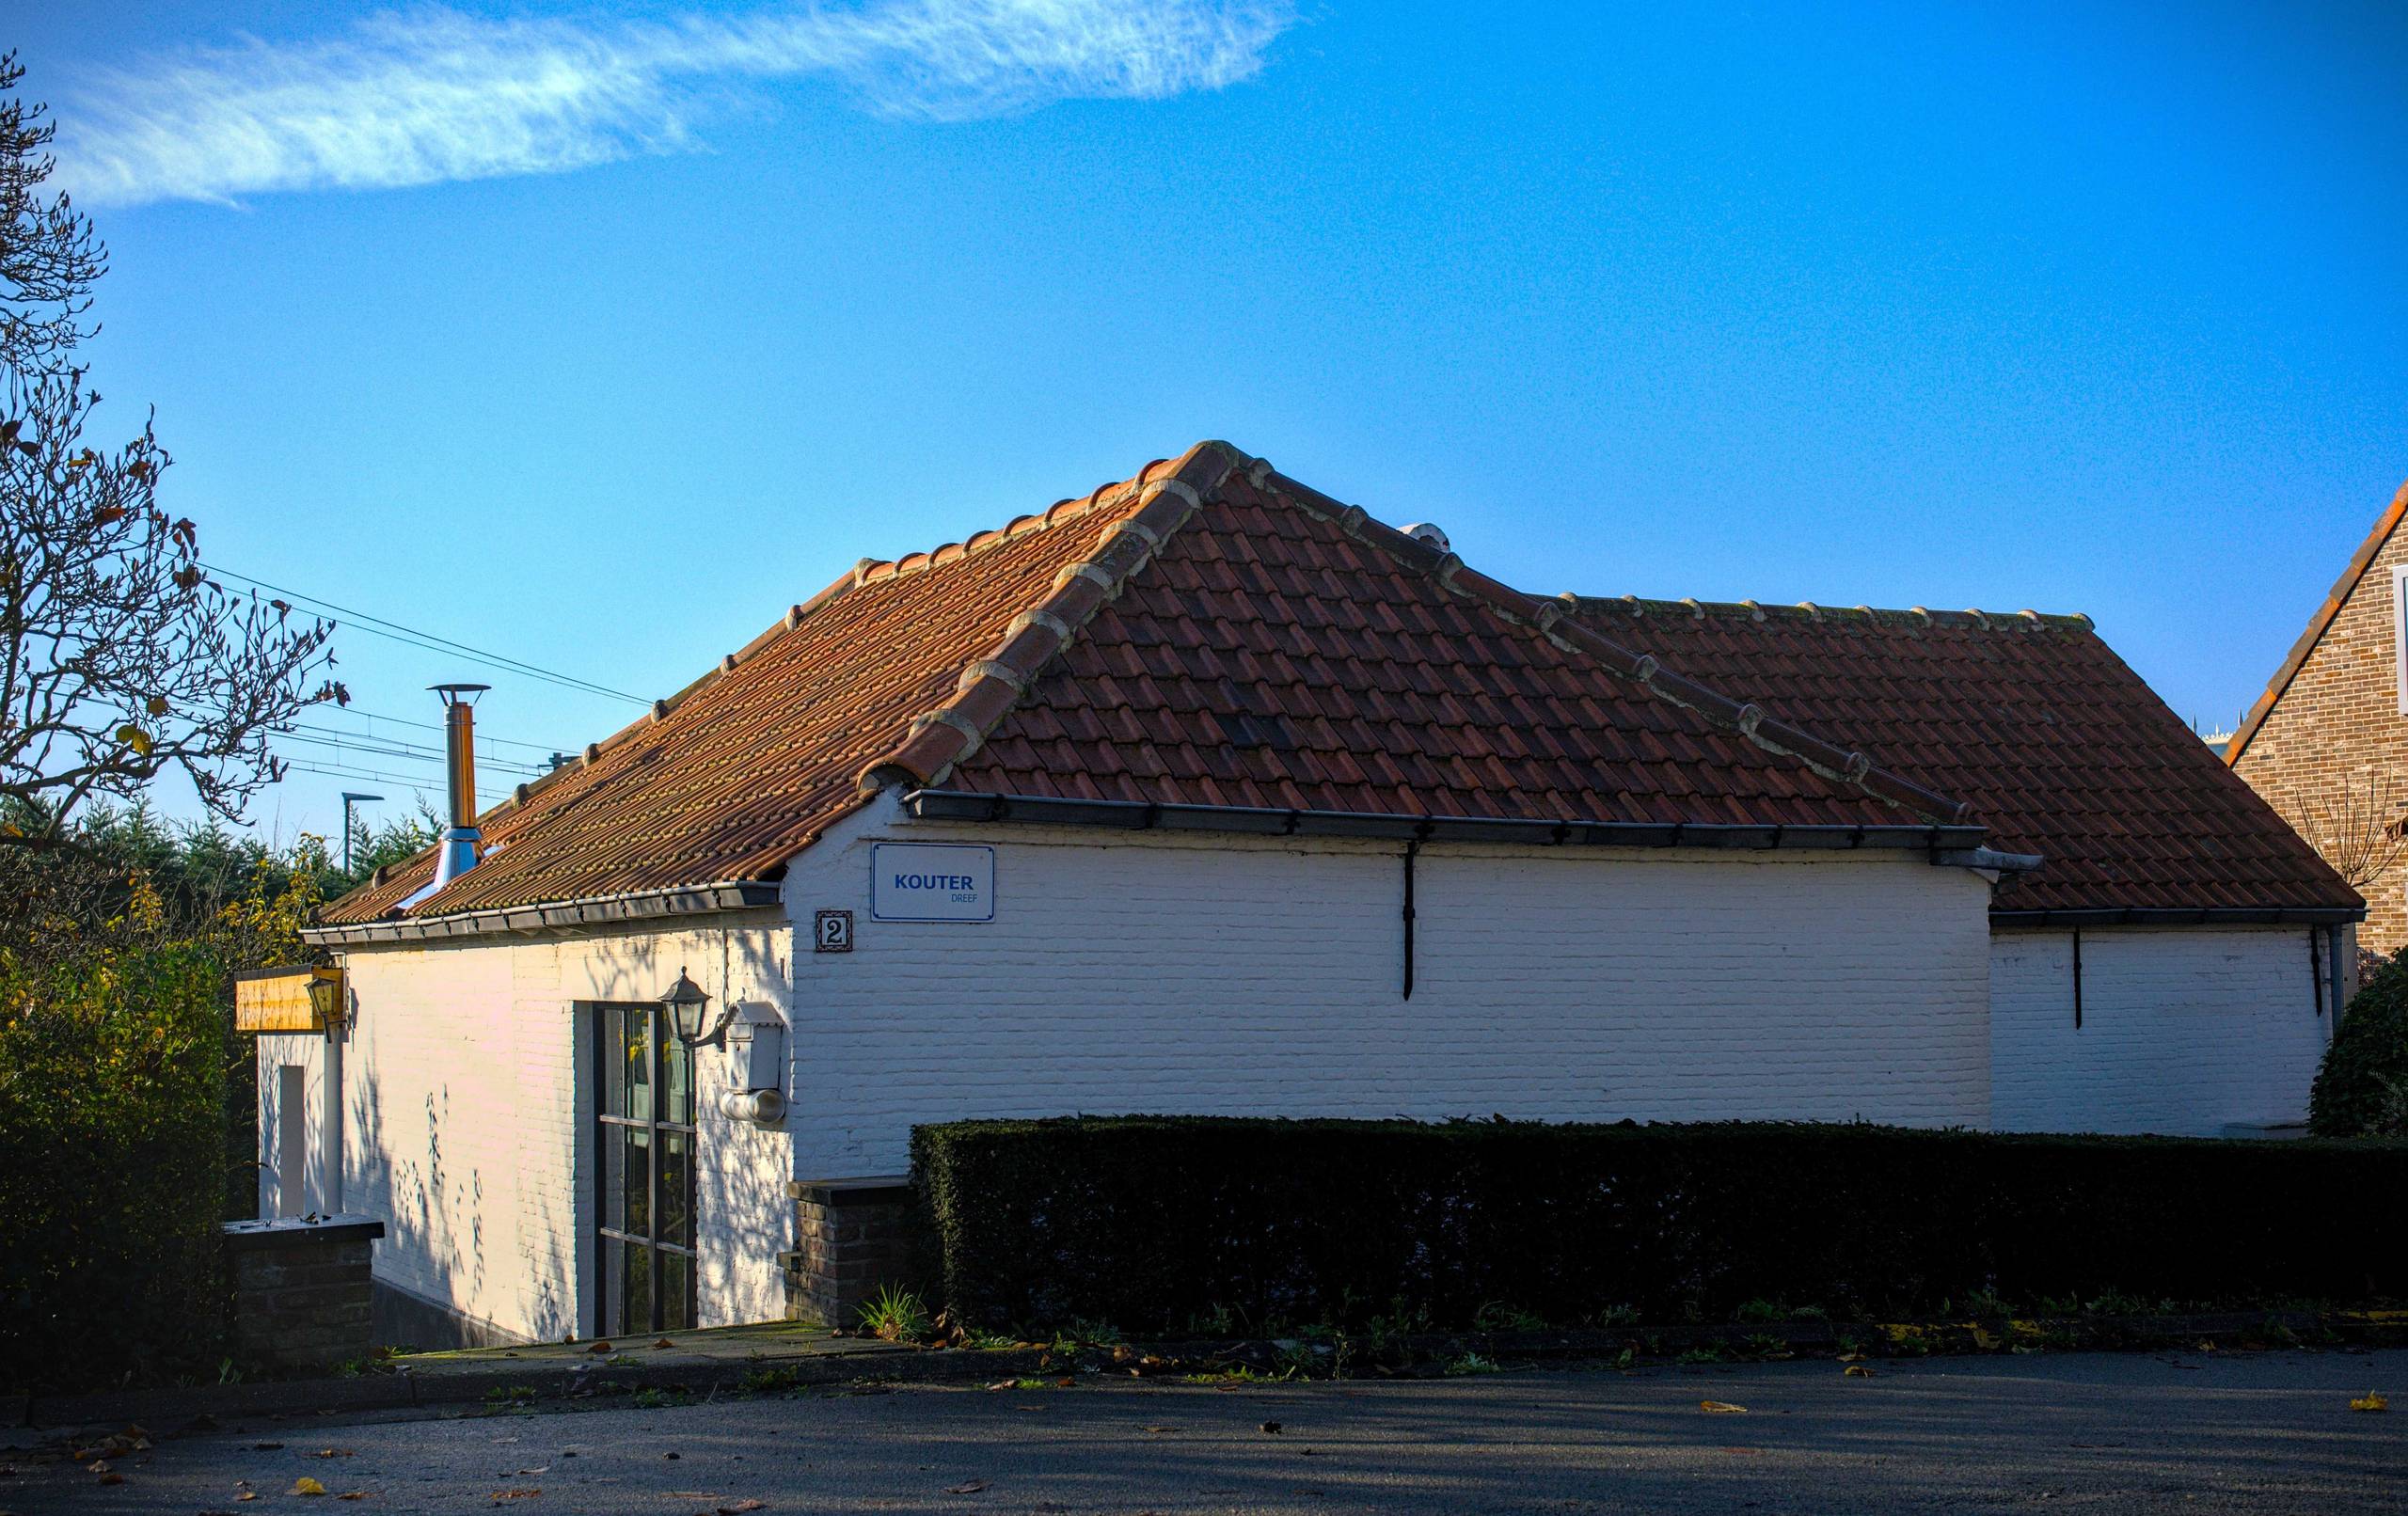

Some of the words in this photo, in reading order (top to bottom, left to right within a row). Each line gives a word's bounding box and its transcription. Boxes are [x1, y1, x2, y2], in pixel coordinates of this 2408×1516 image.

[895, 875, 974, 890] KOUTER
[951, 893, 977, 903] DREEF
[827, 920, 842, 943] 2
